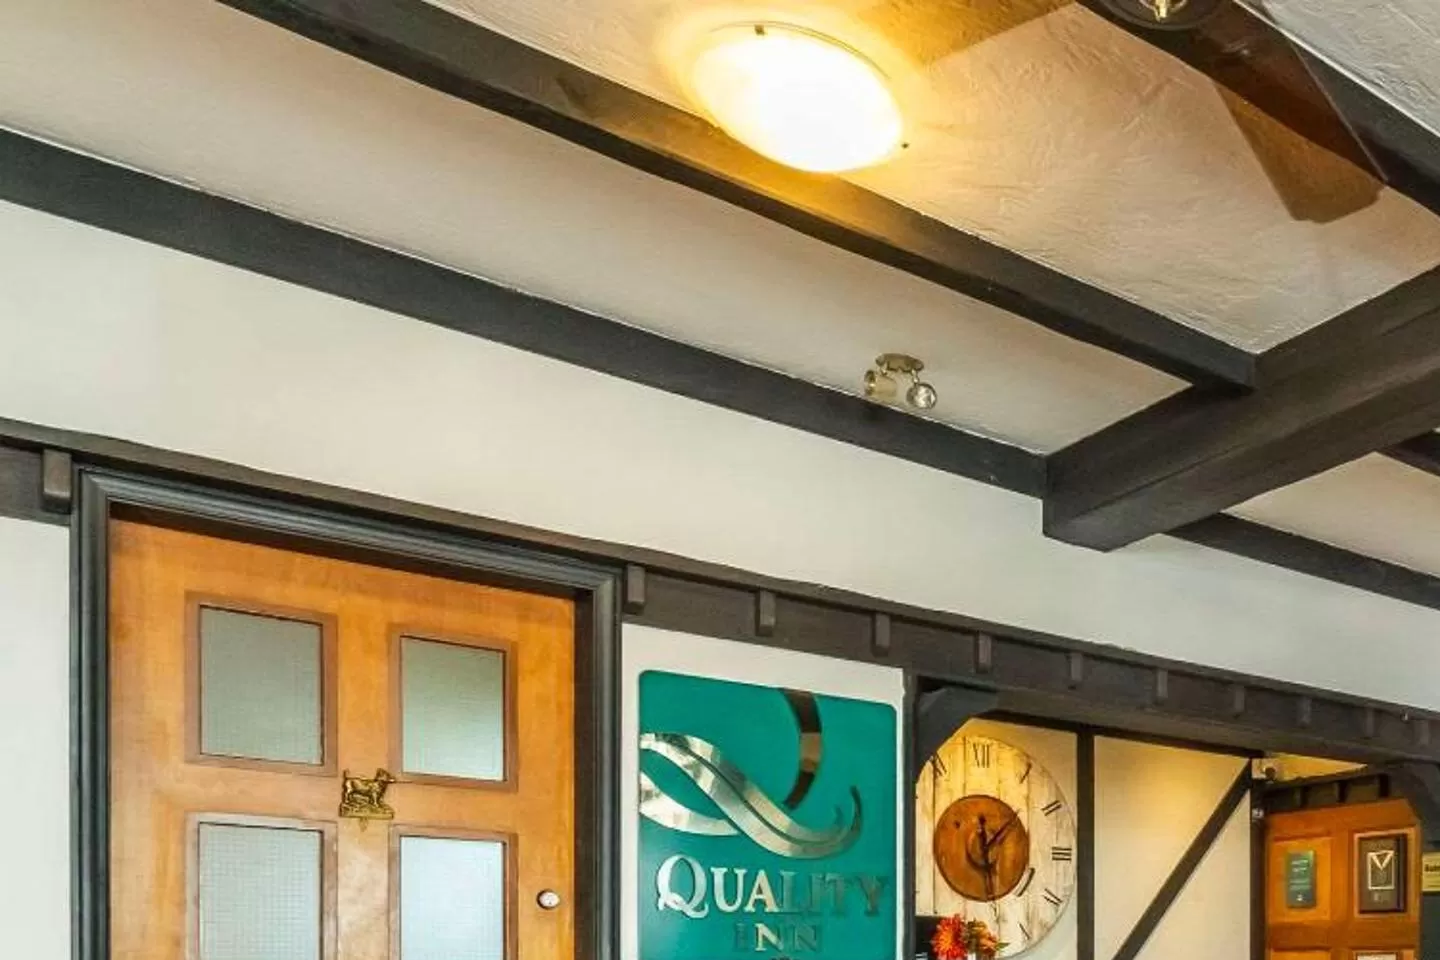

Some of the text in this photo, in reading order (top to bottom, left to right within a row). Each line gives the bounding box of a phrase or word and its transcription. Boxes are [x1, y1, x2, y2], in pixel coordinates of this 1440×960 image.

[1051, 846, 1073, 861] III
[656, 854, 888, 918] QUALITY
[733, 923, 821, 952] INN
